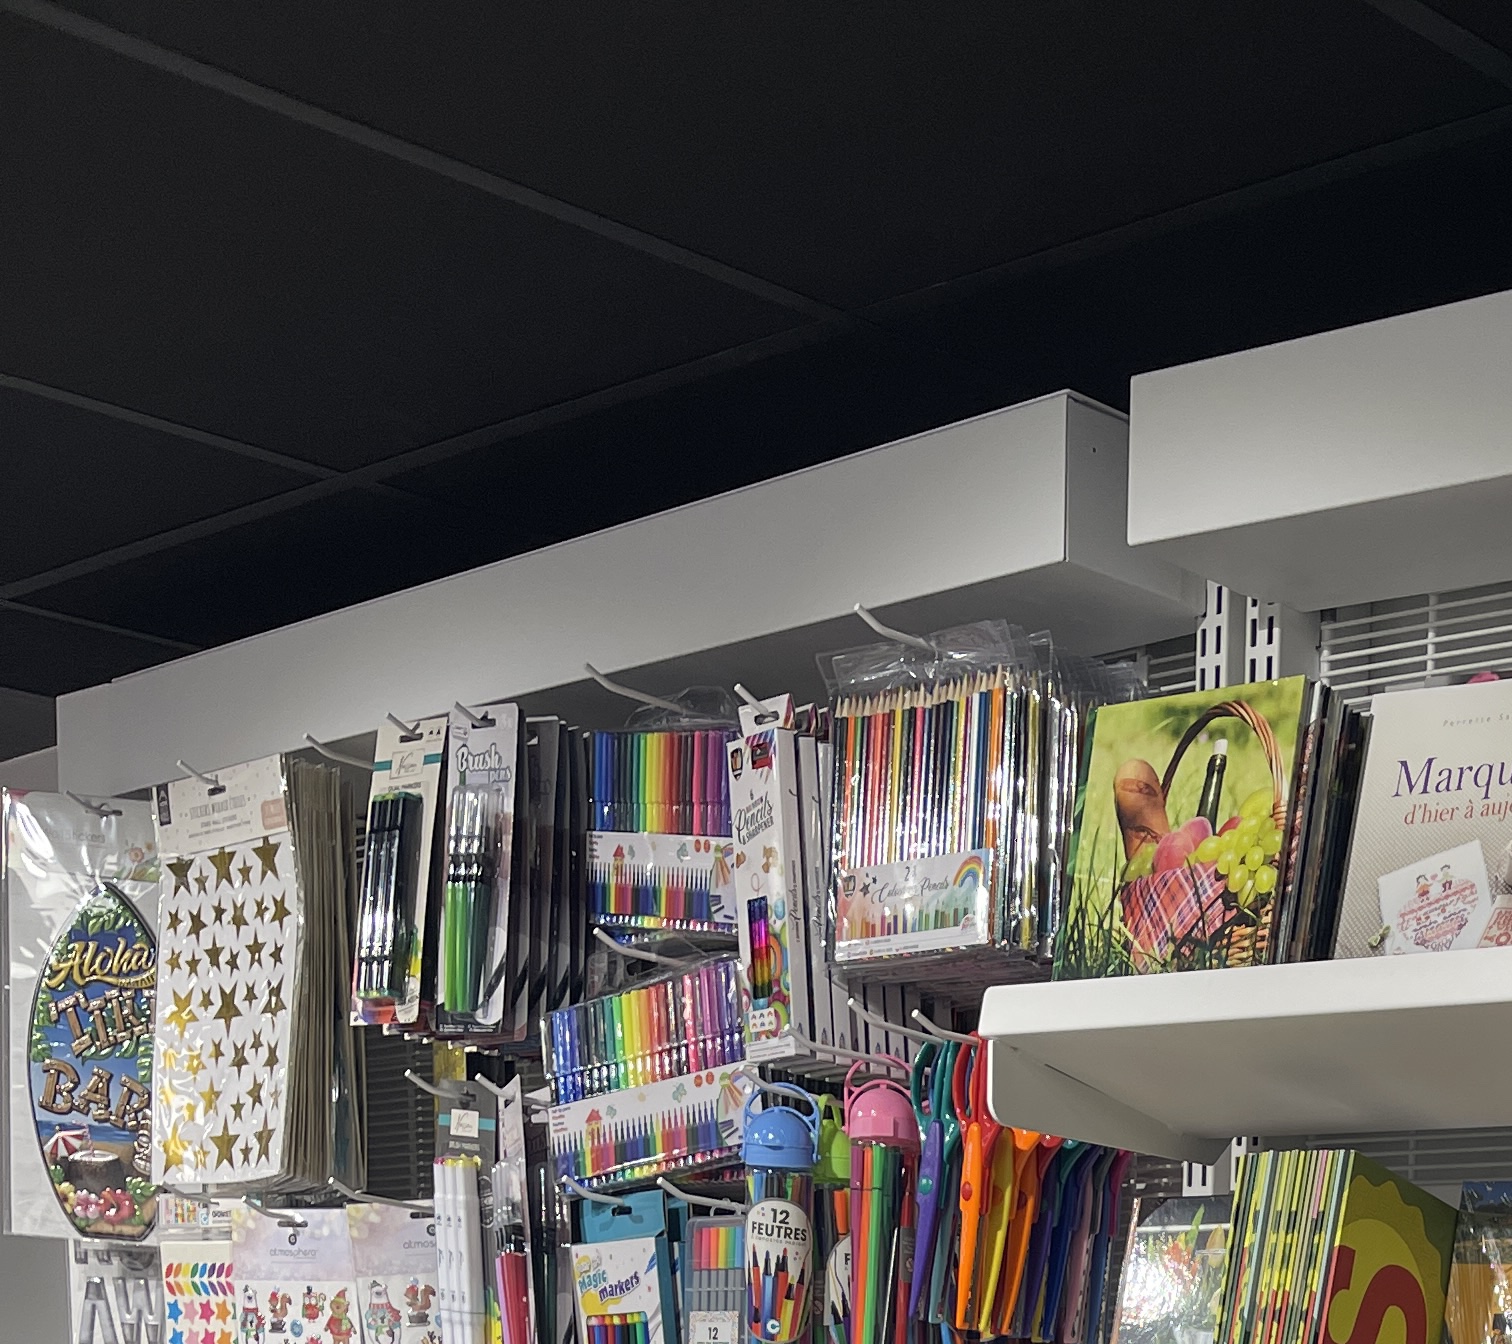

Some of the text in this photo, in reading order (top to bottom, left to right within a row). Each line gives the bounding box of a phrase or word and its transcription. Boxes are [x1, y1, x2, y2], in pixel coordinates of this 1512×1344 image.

[1404, 803, 1459, 825] d'hier
[1464, 800, 1473, 819] à
[46, 936, 155, 990] Aloha
[770, 1208, 790, 1225] 12
[751, 1221, 807, 1242] FEUTRES
[578, 1269, 608, 1293] Magic
[599, 1271, 640, 1302] markers
[708, 1327, 718, 1340] 12
